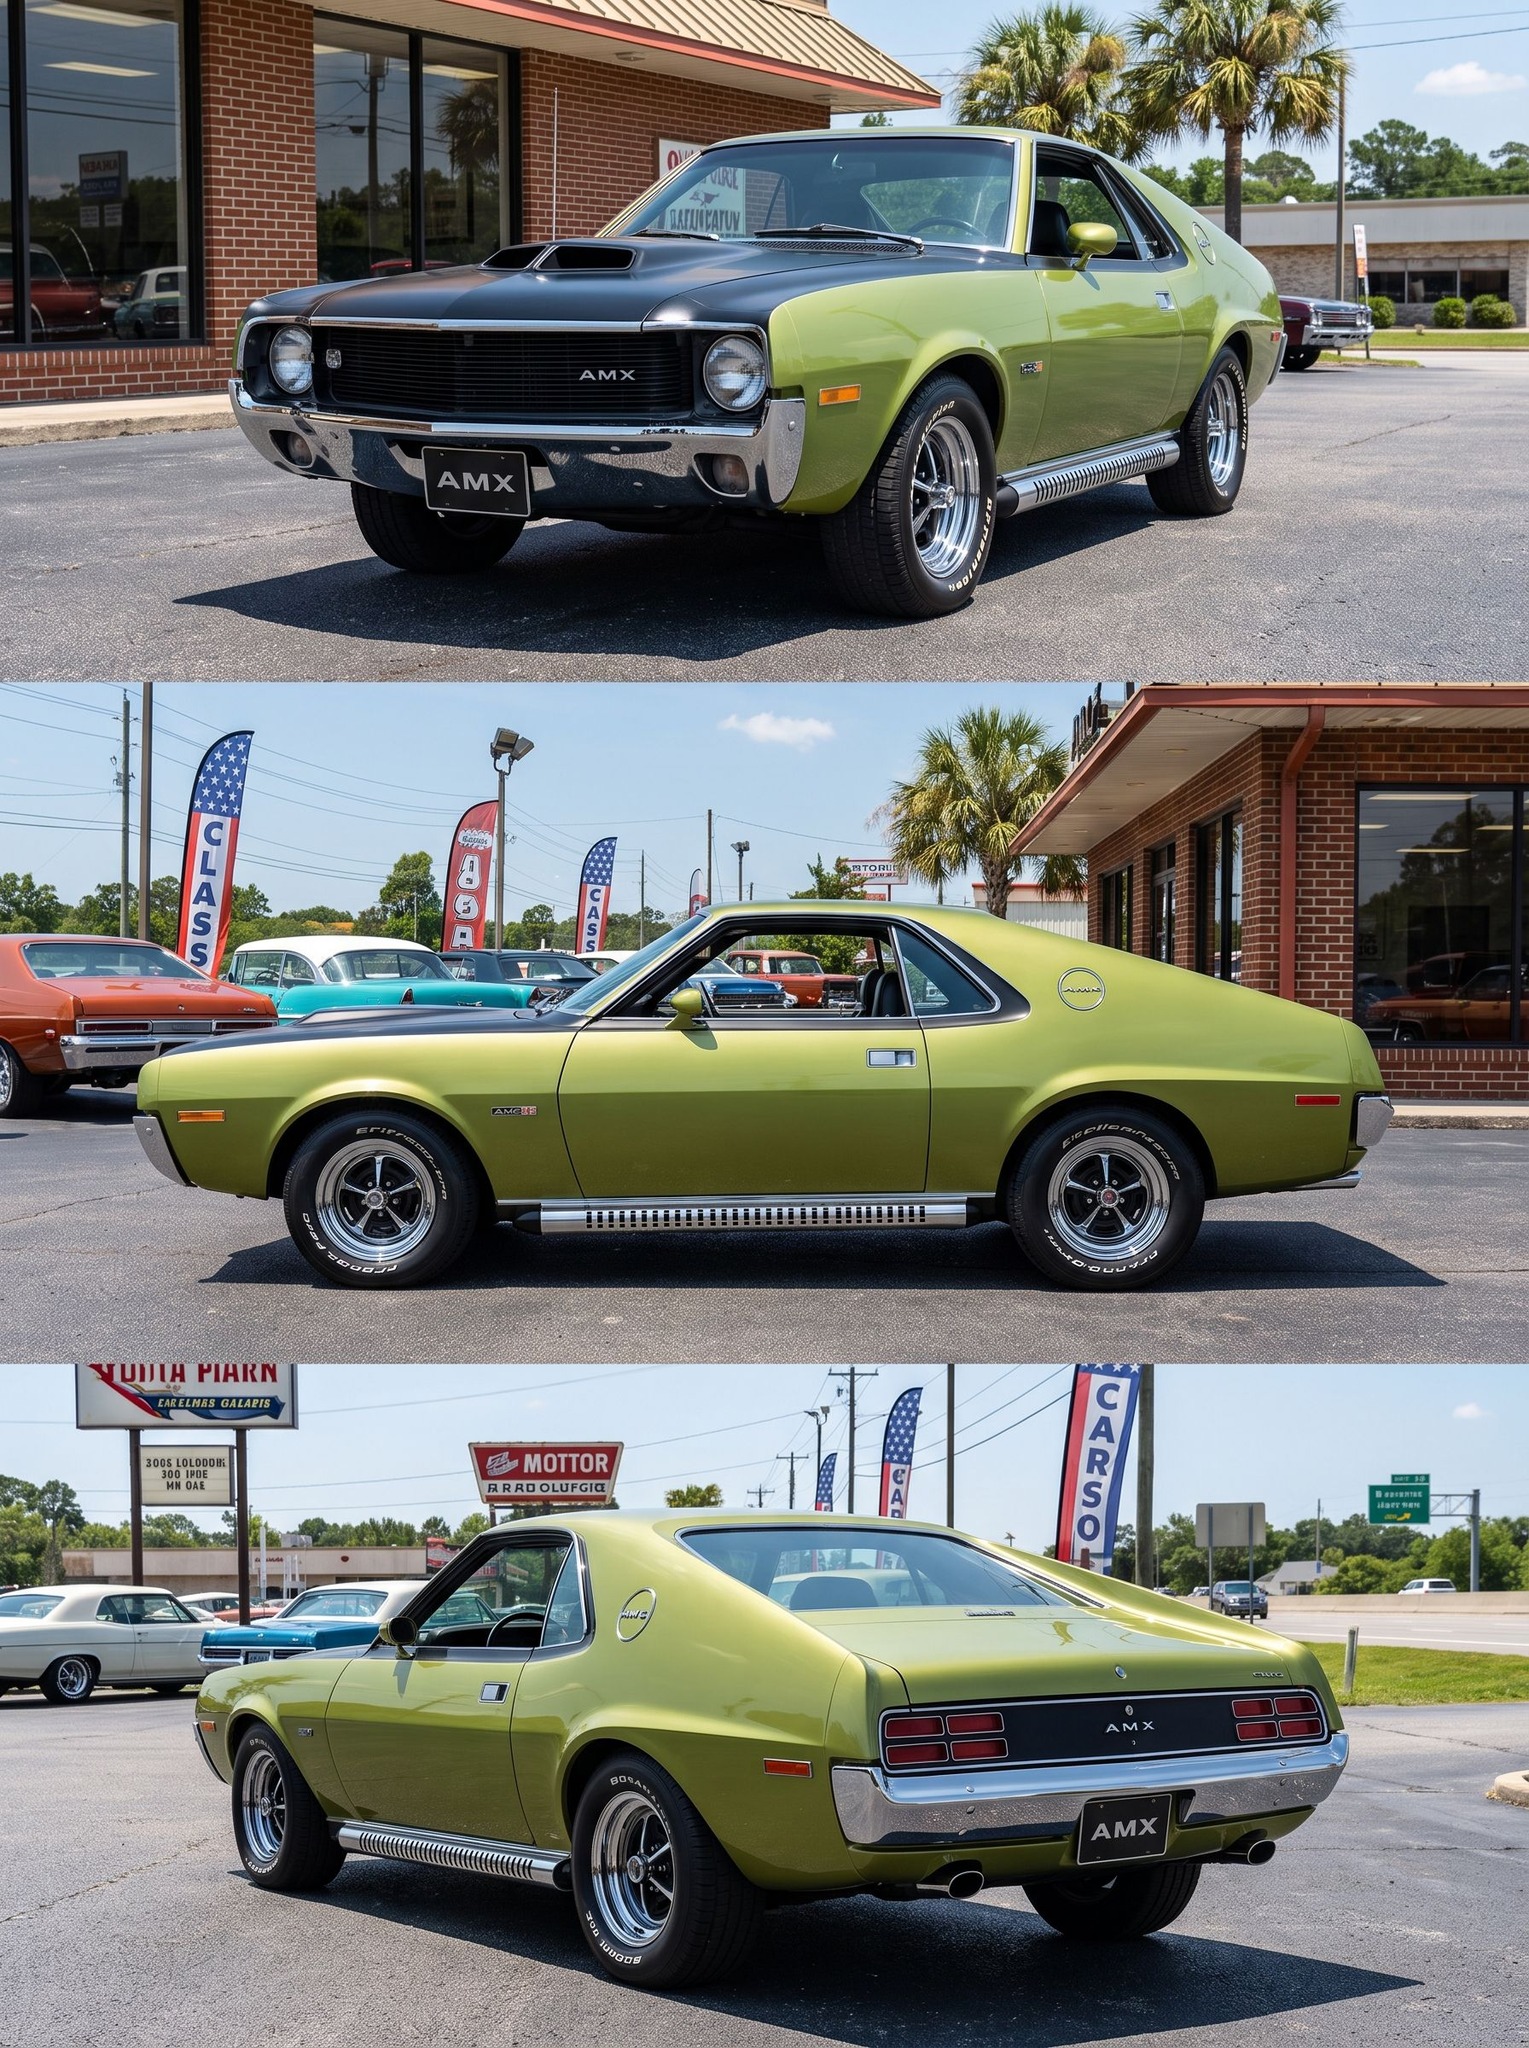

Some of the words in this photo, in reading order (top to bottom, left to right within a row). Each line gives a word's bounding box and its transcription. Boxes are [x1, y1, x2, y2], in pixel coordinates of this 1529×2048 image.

[579, 370, 635, 380] AMX
[437, 471, 516, 493] AMX
[190, 821, 223, 967] CLASS
[586, 888, 602, 953] CASS
[523, 1453, 609, 1473] MOTTOR
[1077, 1383, 1121, 1542] CARSO
[1105, 1721, 1155, 1733] AMX
[1091, 1817, 1159, 1841] AMX
